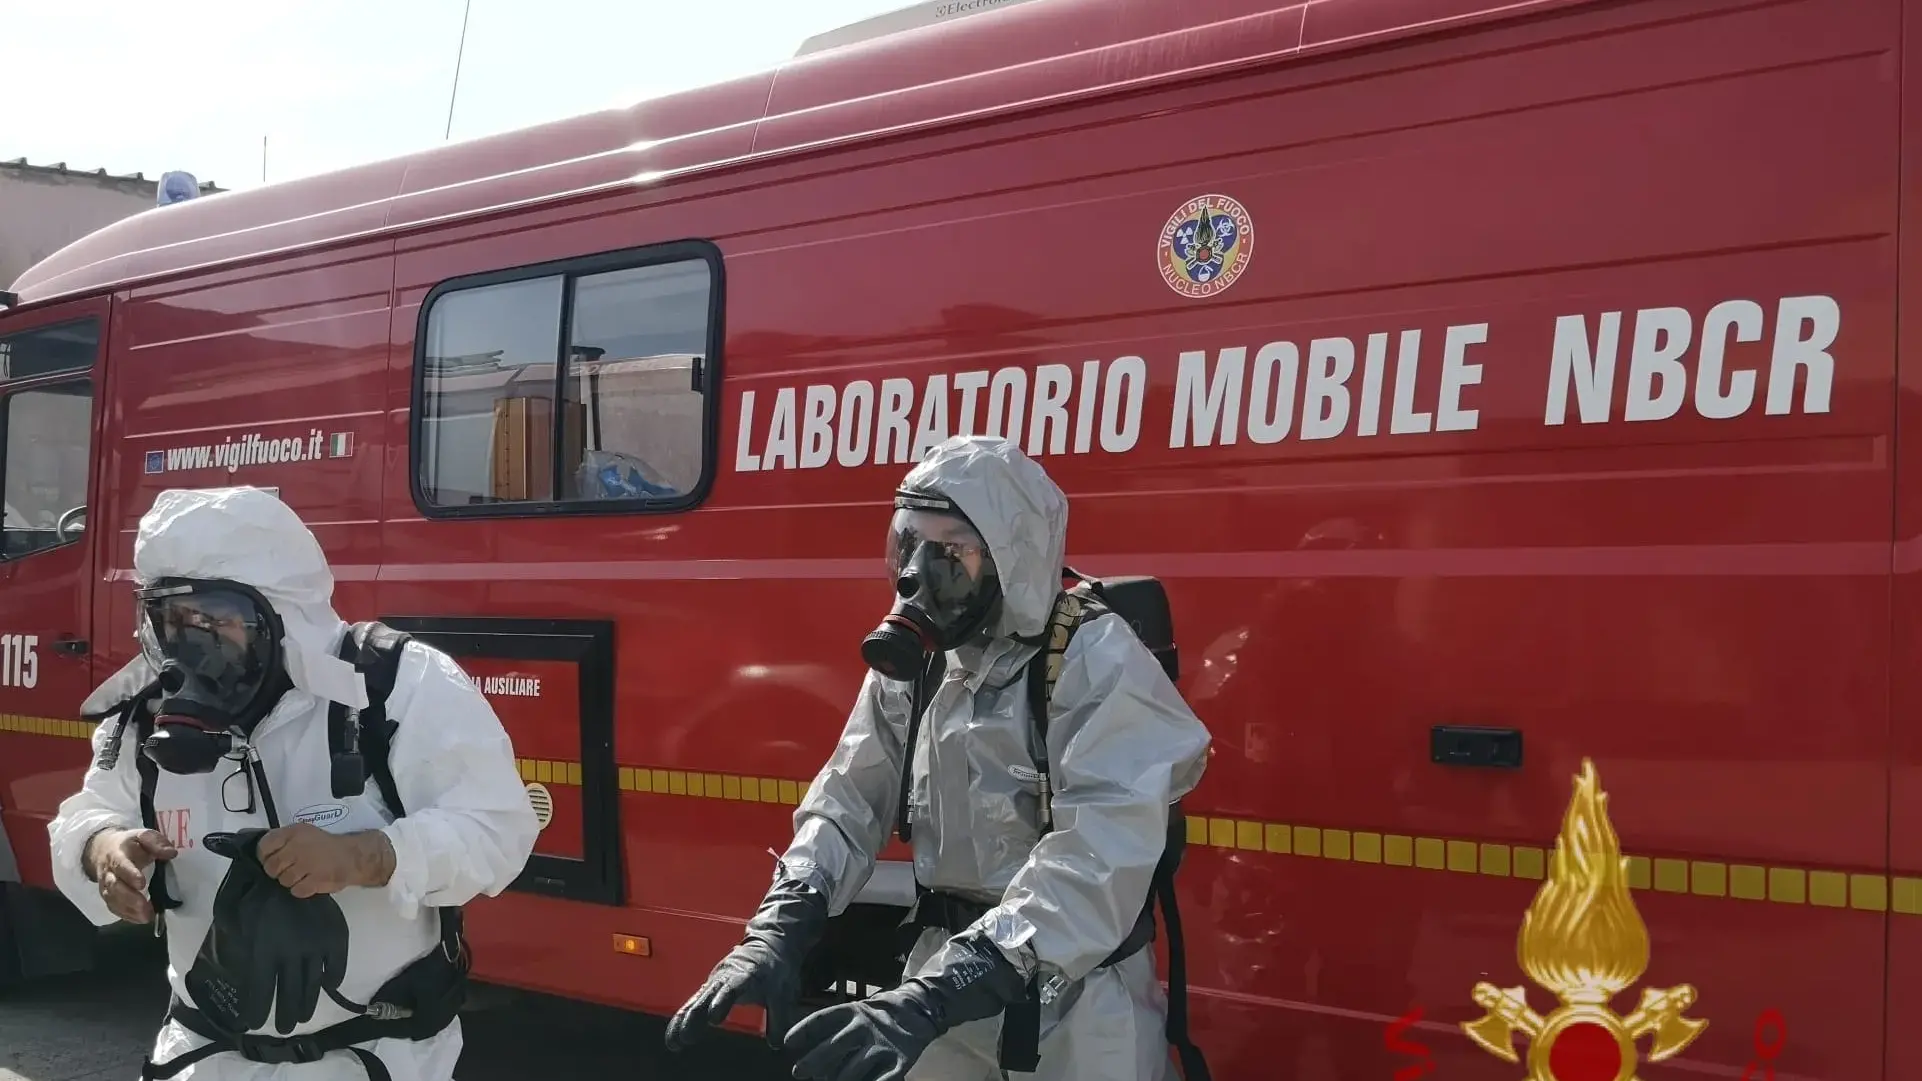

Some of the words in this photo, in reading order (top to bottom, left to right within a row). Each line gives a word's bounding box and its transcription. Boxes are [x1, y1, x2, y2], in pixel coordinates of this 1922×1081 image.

[1160, 210, 1187, 248] VIGILI
[1188, 198, 1213, 213] DEL
[1216, 198, 1250, 235] FUOCO
[1163, 263, 1211, 295] NUCLEO
[1214, 252, 1247, 290] NBCR
[735, 355, 1147, 472] LABORATORIO
[1168, 322, 1489, 449] MOBILE
[1544, 294, 1841, 426] NBCR
[167, 428, 323, 473] www.vigilfuoco.it
[1, 634, 39, 689] 115
[484, 676, 541, 697] AUSILIARE
